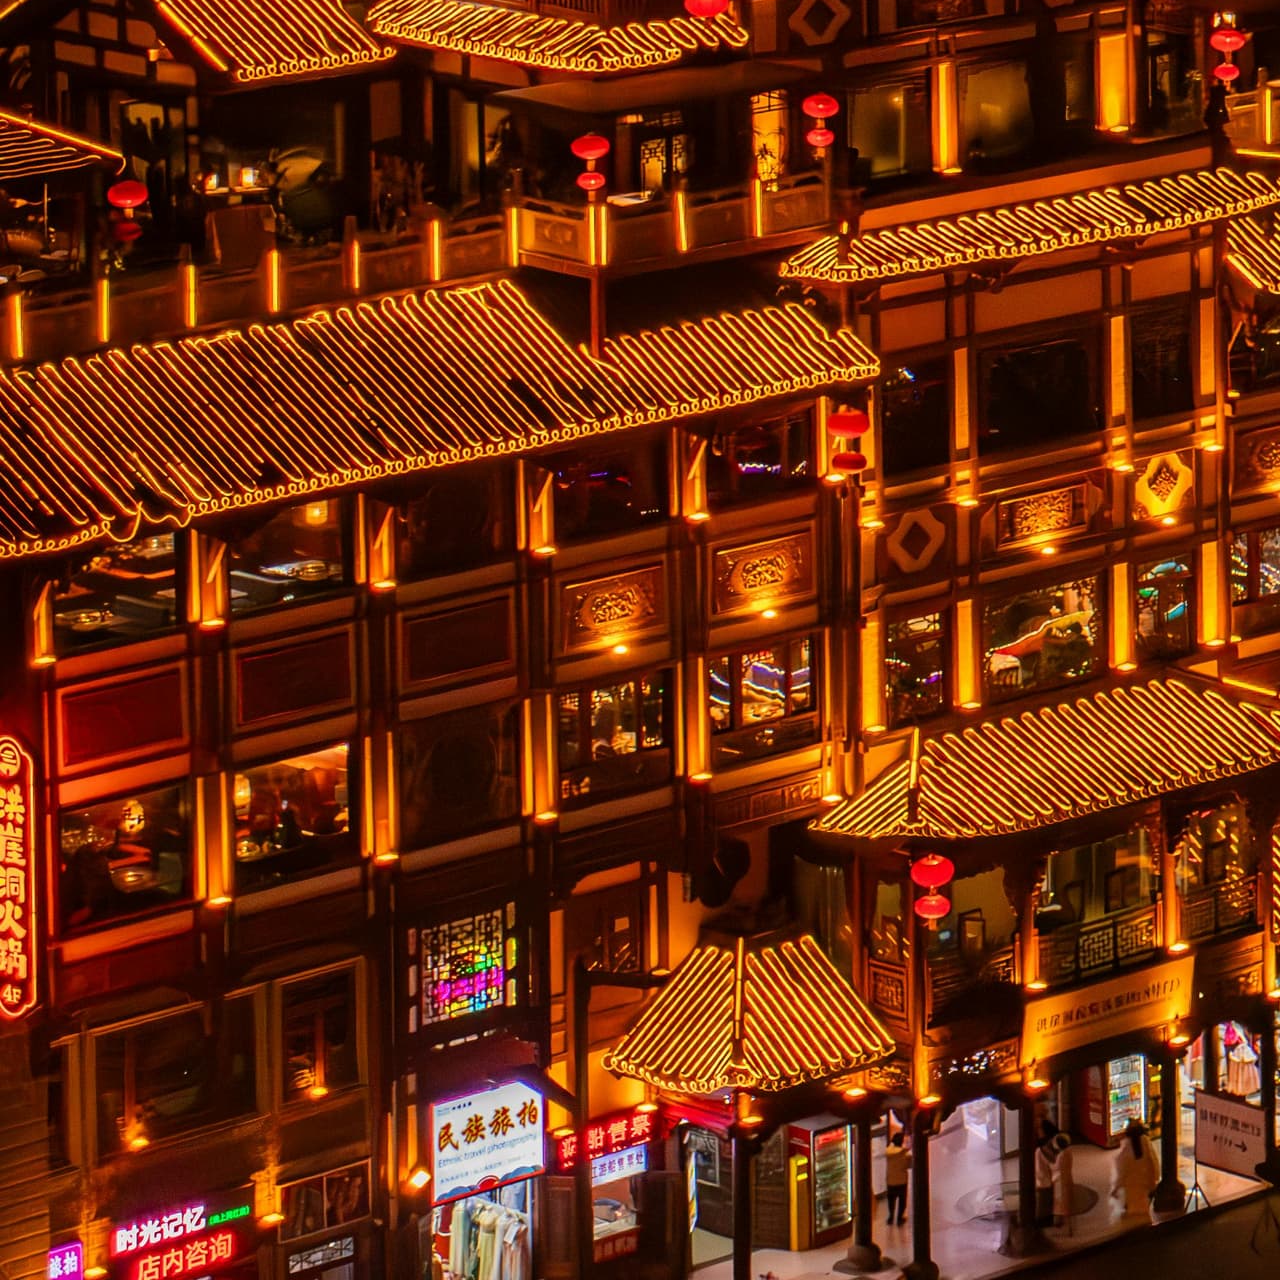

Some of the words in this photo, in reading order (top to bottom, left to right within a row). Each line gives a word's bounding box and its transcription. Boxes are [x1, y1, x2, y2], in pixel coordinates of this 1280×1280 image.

[3, 983, 22, 1004] 4F
[438, 1098, 538, 1152] 民族旅拍
[116, 1206, 206, 1252] 时光记忆
[138, 1234, 233, 1280] 店内咨询
